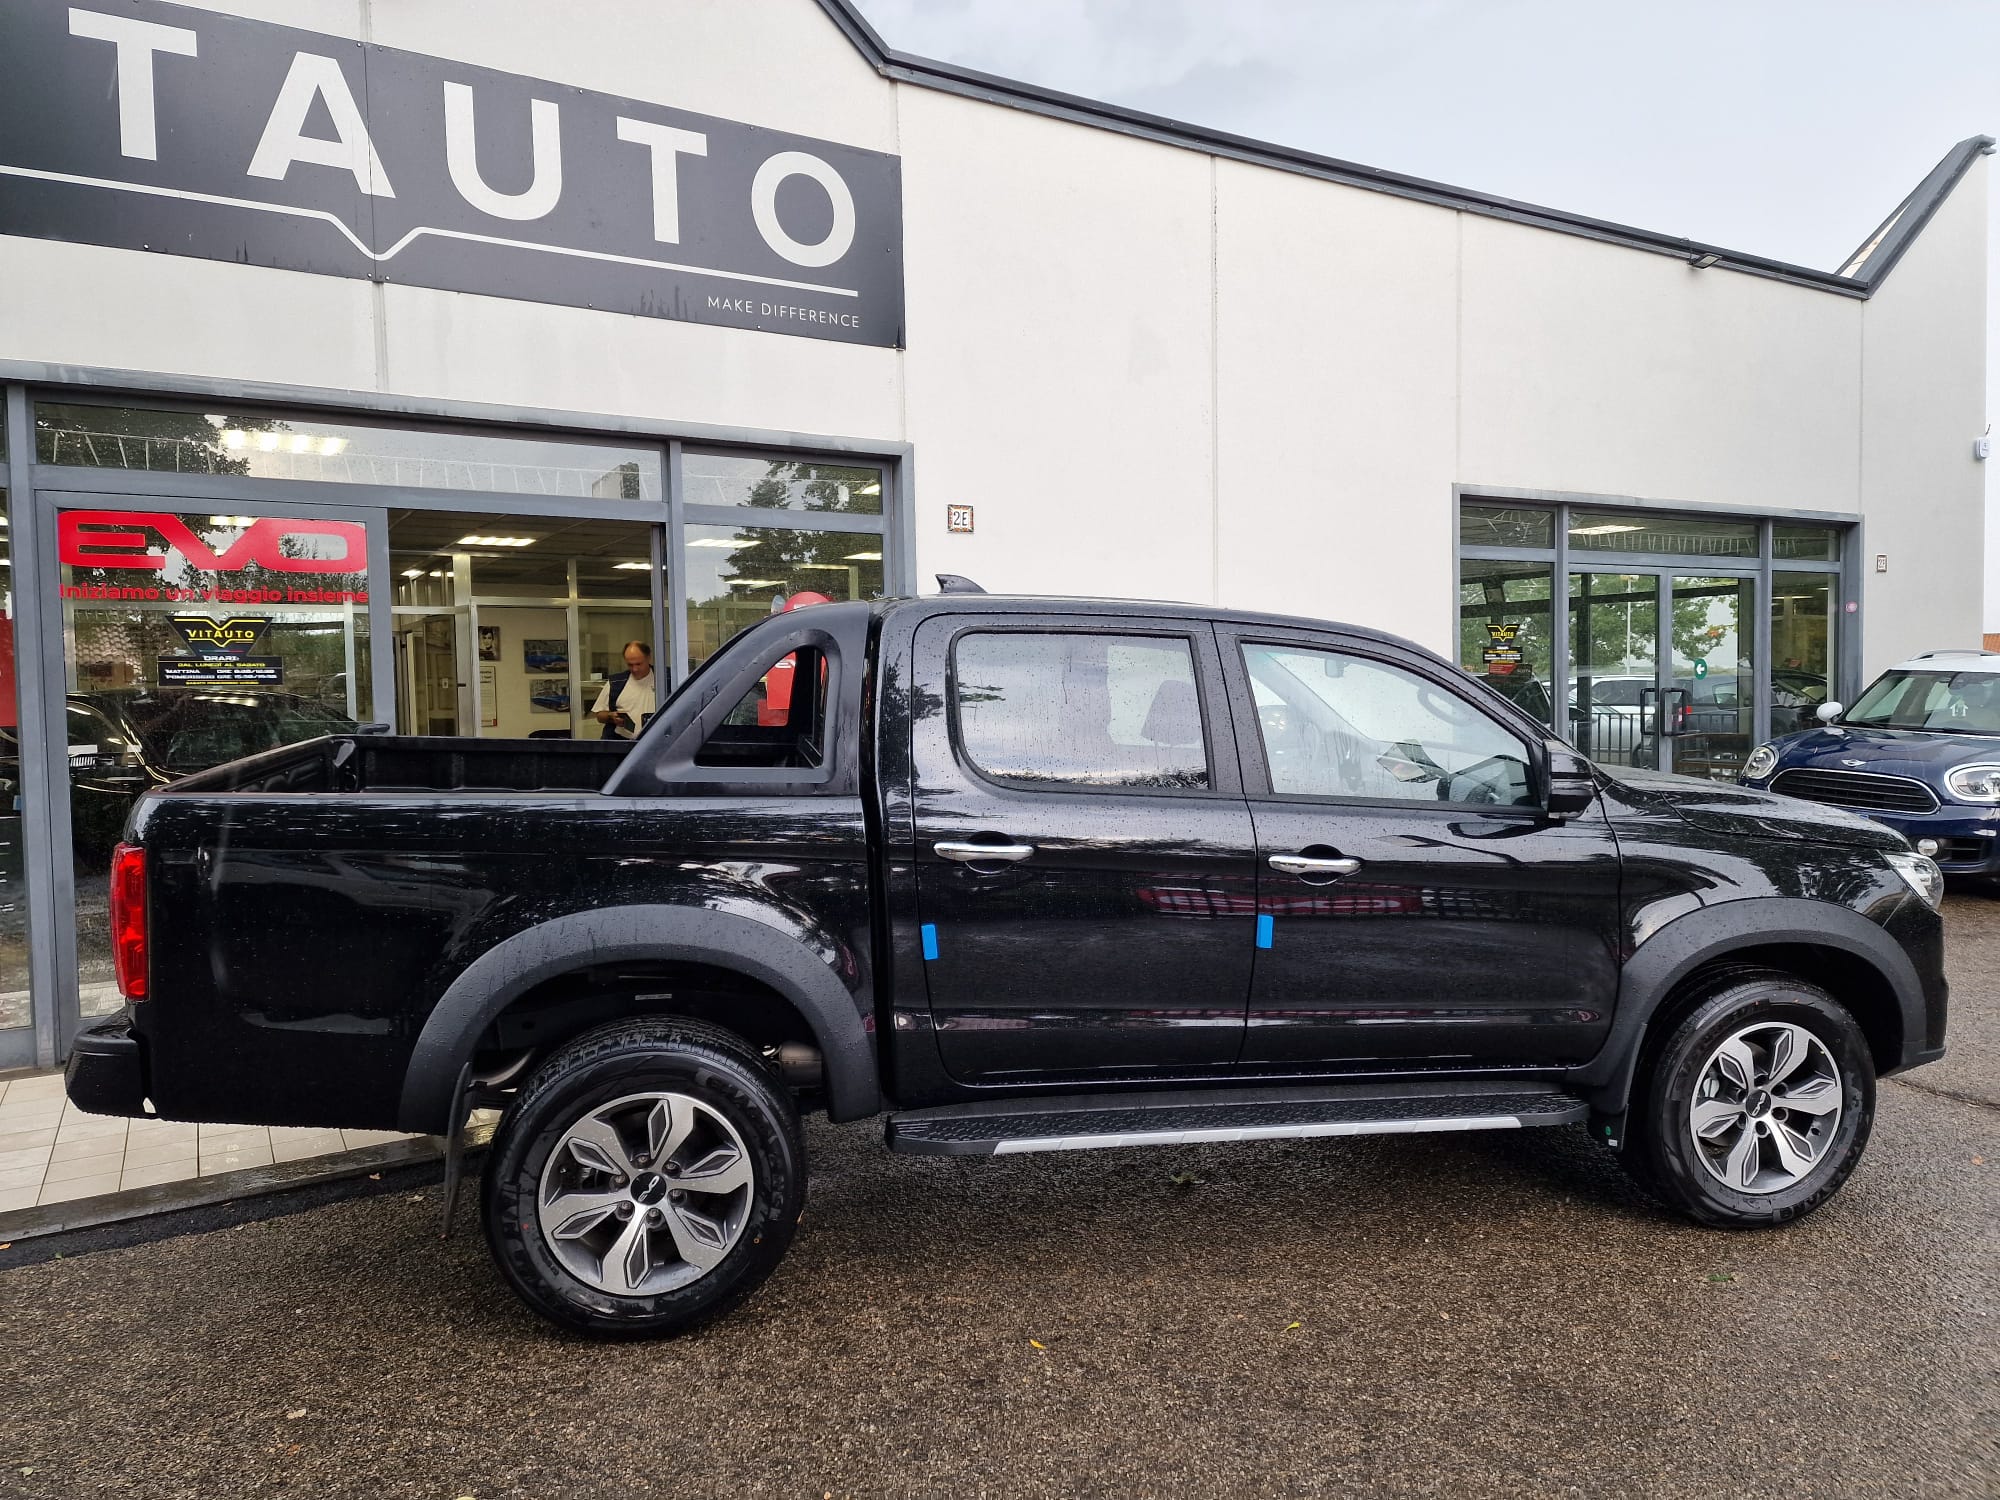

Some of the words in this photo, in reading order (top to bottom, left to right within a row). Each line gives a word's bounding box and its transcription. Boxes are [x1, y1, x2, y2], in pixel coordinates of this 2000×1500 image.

[69, 7, 856, 267] TAUTO
[707, 295, 753, 313] MAKE
[761, 302, 860, 328] DIFFERENCE
[953, 510, 968, 526] 2E
[58, 510, 367, 573] EVO
[59, 583, 158, 600] Iniziamo
[166, 588, 195, 601] un
[201, 585, 282, 604] viaggio
[287, 586, 369, 603] insieme
[188, 629, 255, 639] VITAUTO
